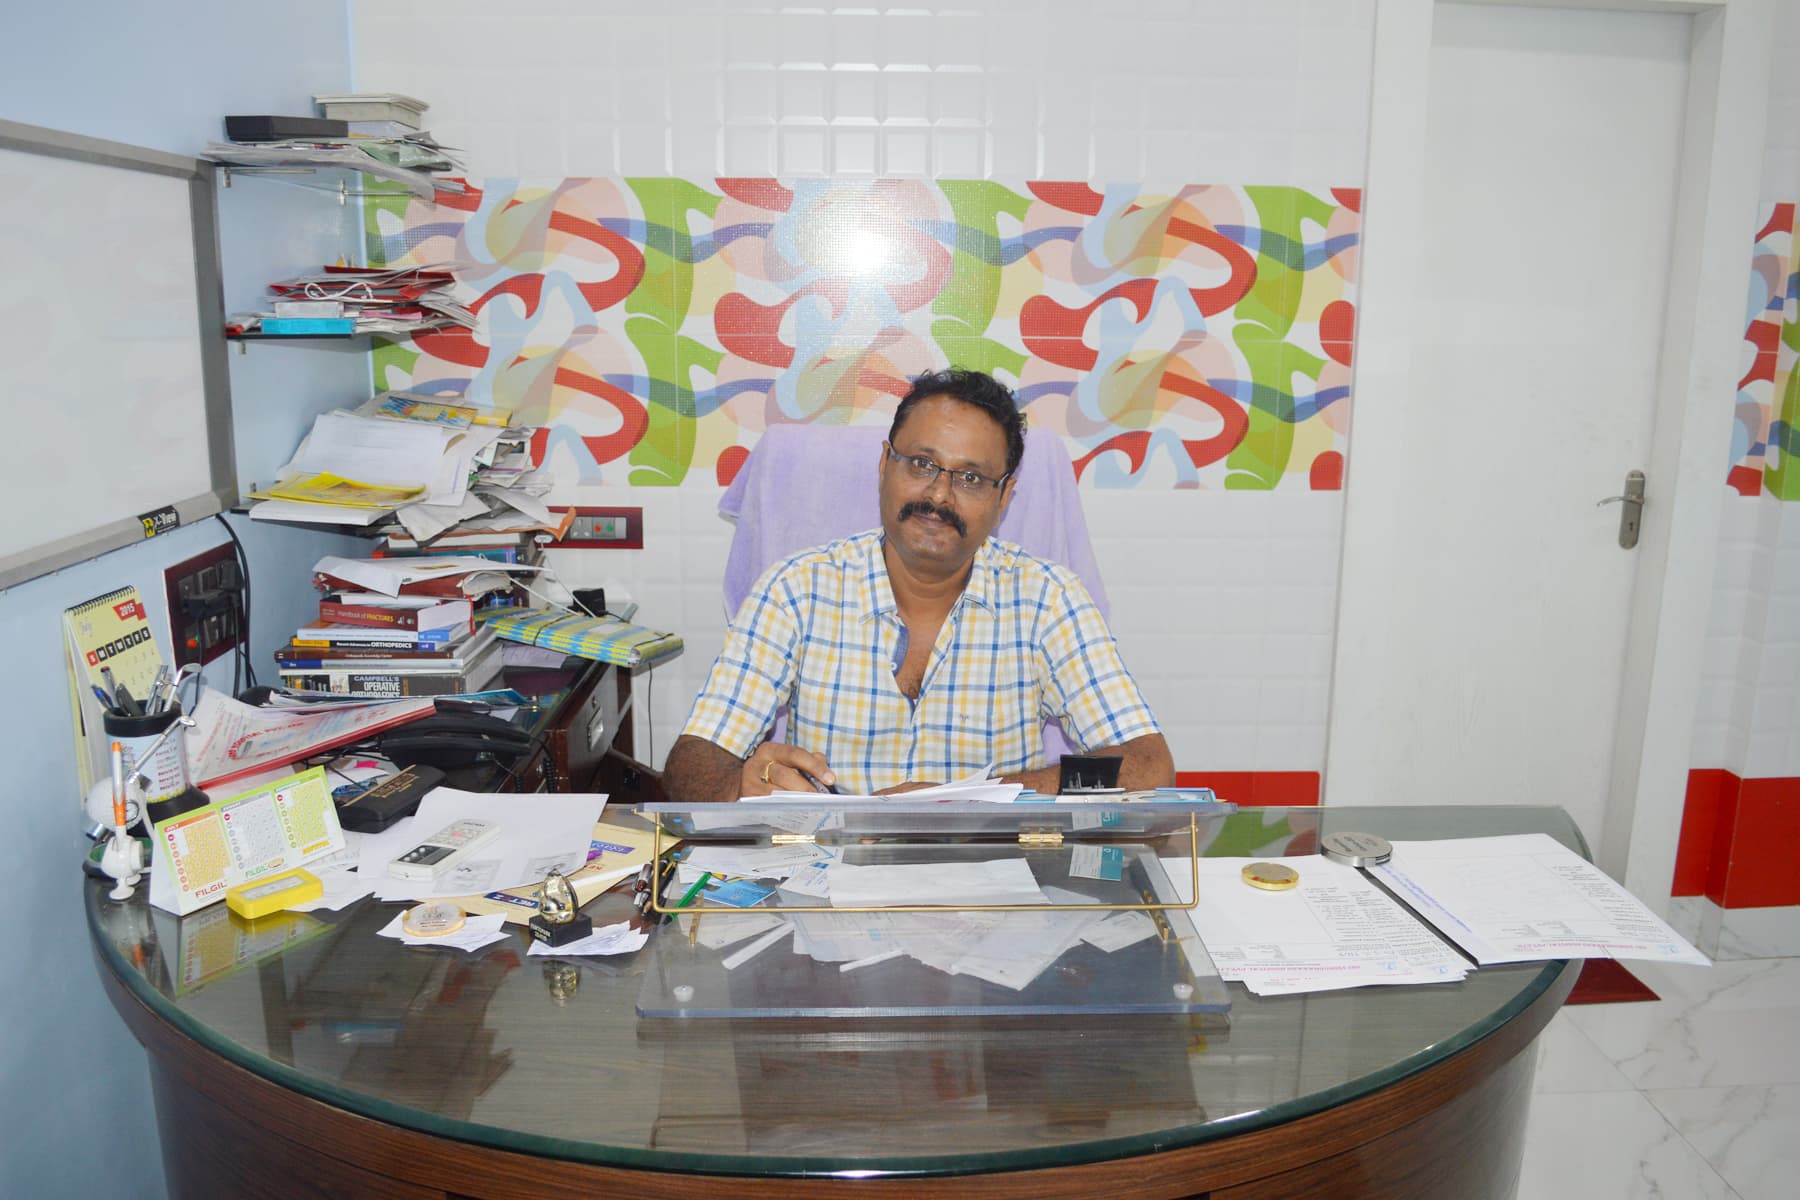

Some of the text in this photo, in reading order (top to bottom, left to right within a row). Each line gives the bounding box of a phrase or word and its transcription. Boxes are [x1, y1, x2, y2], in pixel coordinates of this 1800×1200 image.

[119, 603, 136, 617] 2015
[370, 641, 412, 649] ORTHOPEDICS
[364, 682, 400, 692] OPERATIVE
[195, 881, 226, 897] FILGIL
